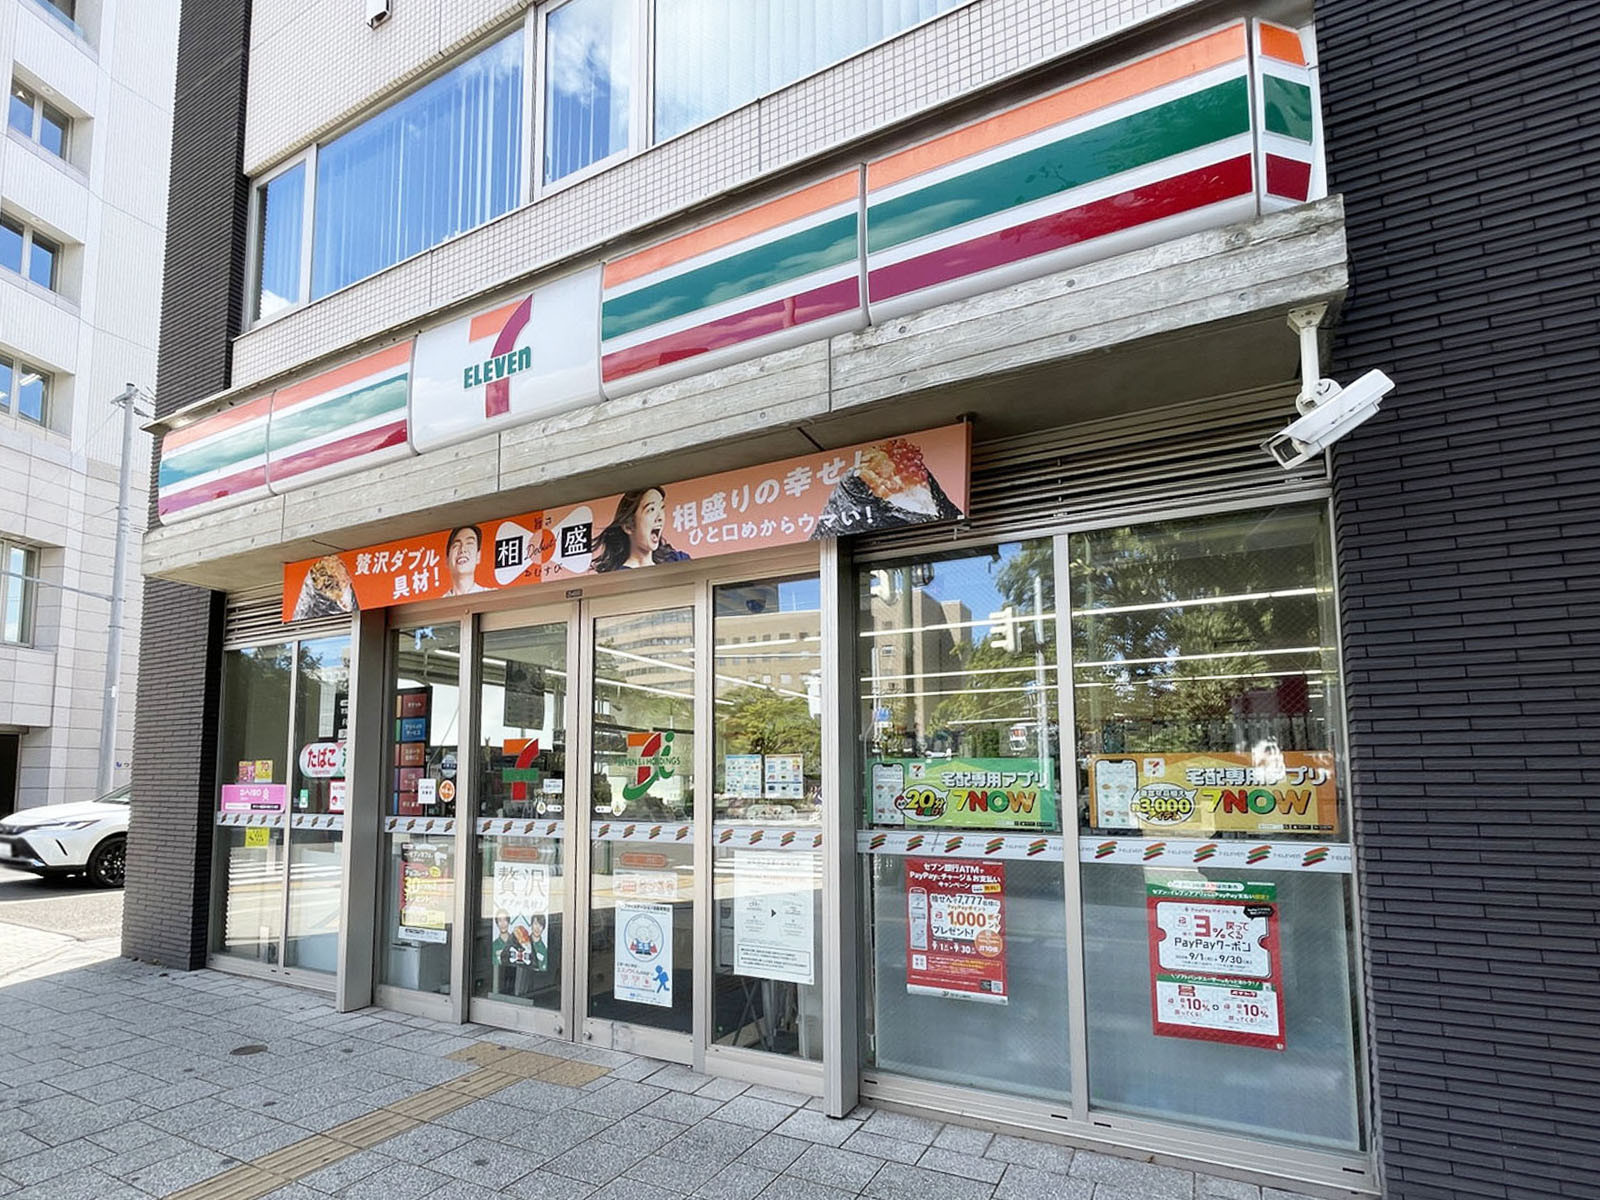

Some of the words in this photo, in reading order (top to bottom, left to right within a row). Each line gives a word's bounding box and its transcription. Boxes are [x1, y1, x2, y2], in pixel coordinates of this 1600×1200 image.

[688, 505, 873, 546] ひと口めからウマい!
[498, 539, 519, 566] 相
[565, 525, 588, 556] 盛
[354, 546, 440, 576] 贅沢ダブル
[392, 566, 440, 600] 具材!
[307, 748, 337, 769] たばこ
[941, 771, 1048, 789] 宅配専用アプリ
[953, 789, 1036, 813] 7NOW
[1202, 788, 1311, 815] 7NOW
[932, 925, 974, 938] プレゼント!
[1174, 937, 1251, 952] PayPayクーポン
